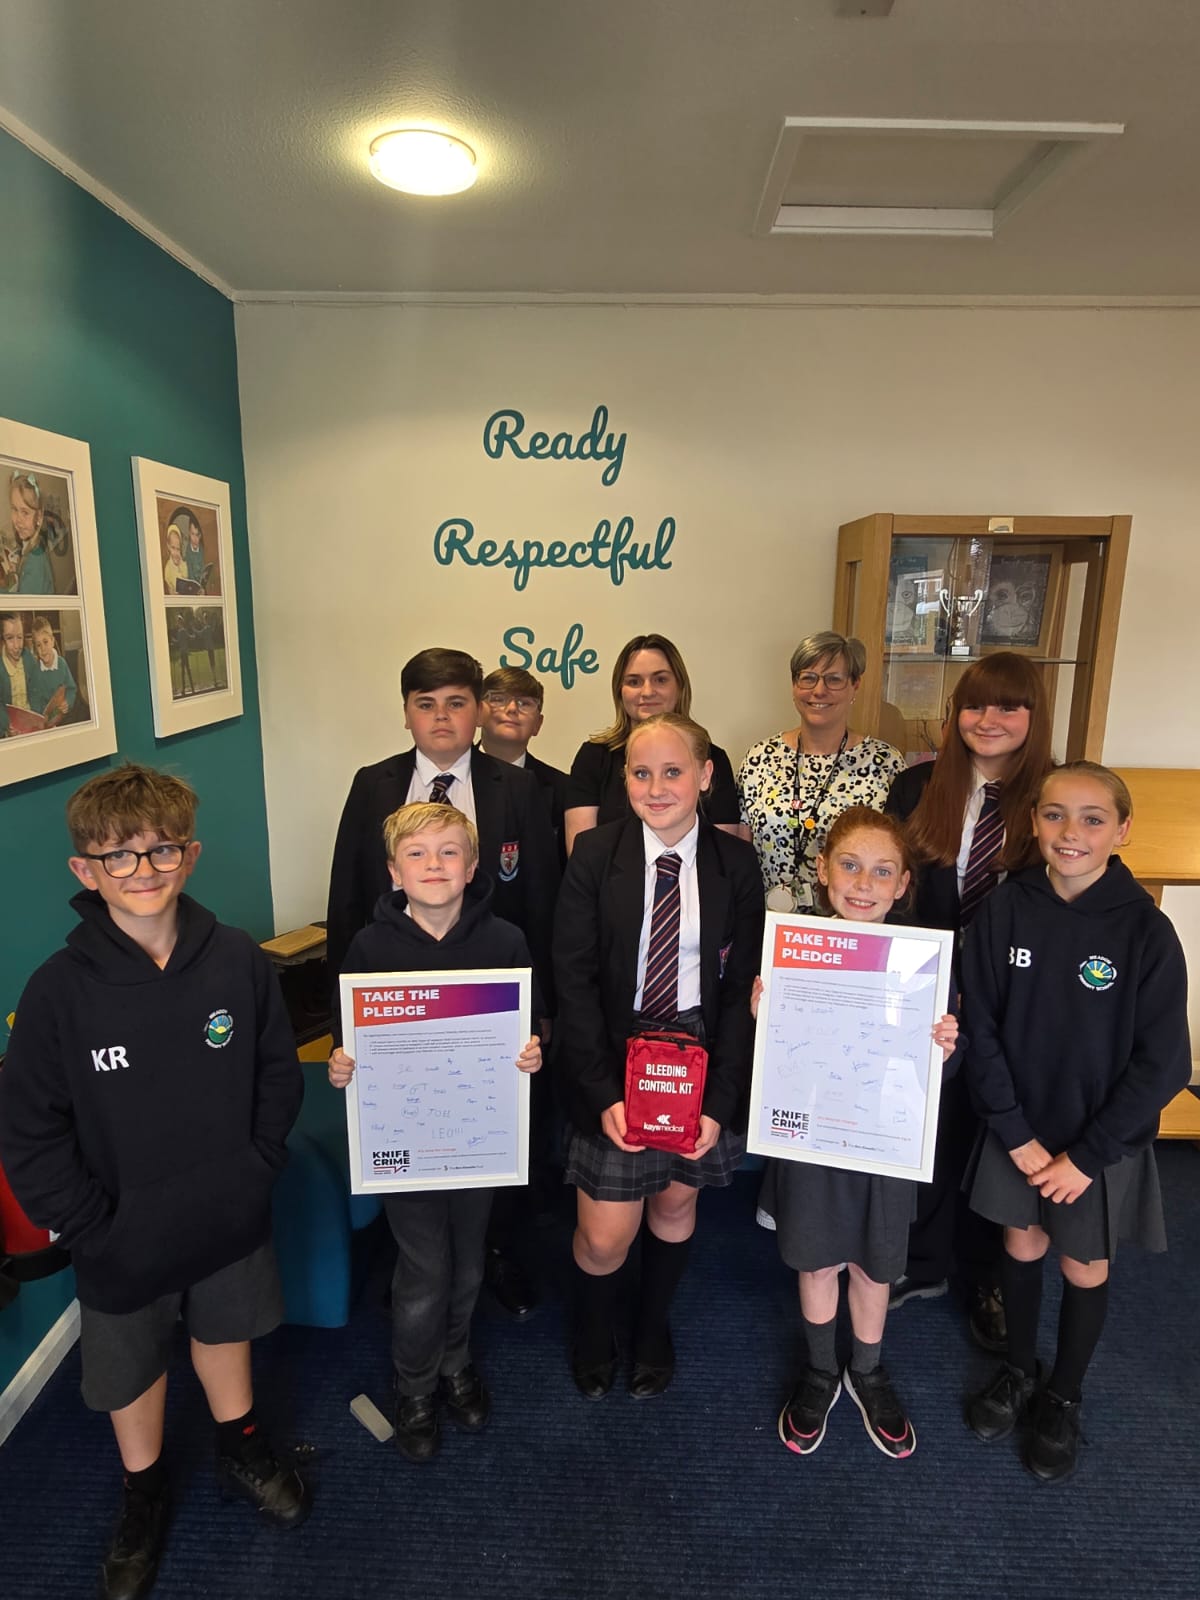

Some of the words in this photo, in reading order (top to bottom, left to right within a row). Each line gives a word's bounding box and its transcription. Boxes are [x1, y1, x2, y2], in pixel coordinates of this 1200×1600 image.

[483, 405, 627, 486] Ready
[434, 516, 676, 591] Respectful
[500, 623, 600, 690] Safe
[783, 931, 824, 948] TAKE
[827, 936, 859, 950] THE
[782, 947, 843, 965] PLEDGE
[362, 990, 405, 1003] TAKE
[408, 988, 440, 1001] THE
[363, 1004, 427, 1018] PLEDGE
[91, 1045, 130, 1072] KR
[645, 1063, 688, 1078] BLEEDING
[638, 1079, 678, 1094] CONTROL
[679, 1082, 694, 1095] KIT
[772, 1108, 810, 1122] KNIFE
[771, 1117, 809, 1131] CRIME
[372, 1150, 410, 1159] KNIFE
[373, 1158, 411, 1167] CRIME
